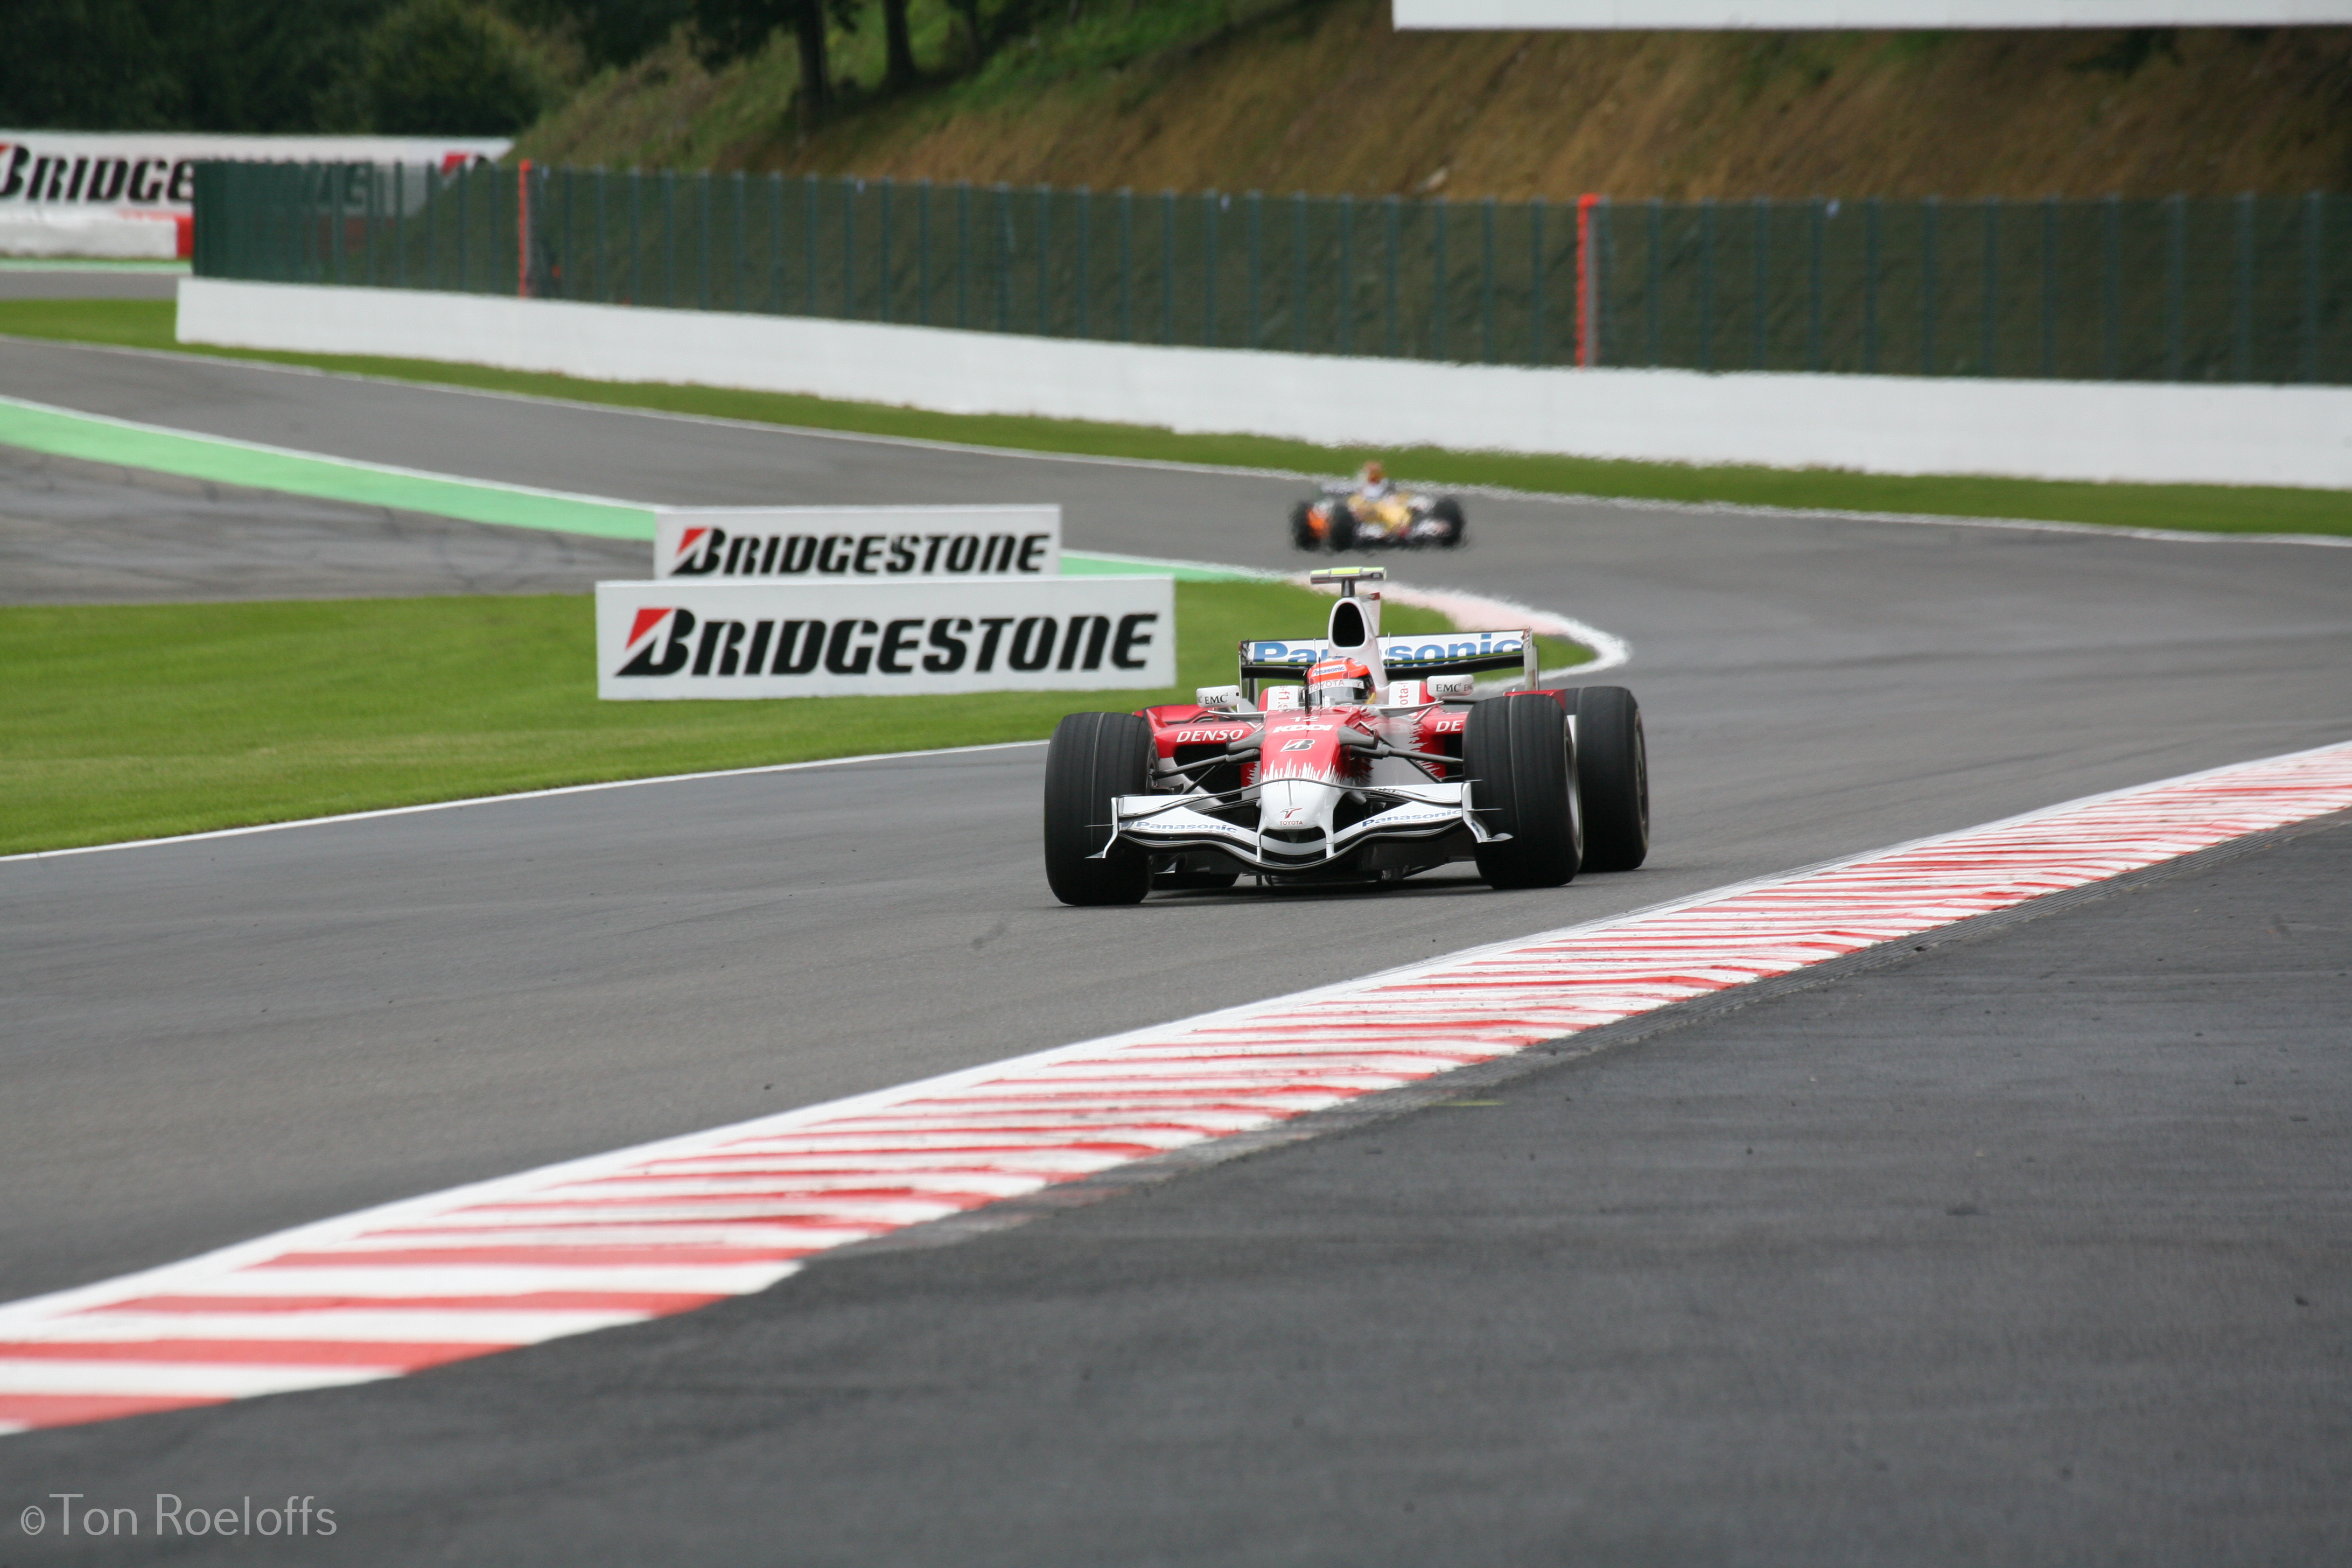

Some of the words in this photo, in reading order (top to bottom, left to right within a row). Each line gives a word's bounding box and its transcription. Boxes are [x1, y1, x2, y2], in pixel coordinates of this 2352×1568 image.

[670, 527, 1050, 575] BRIDGESTONE
[613, 607, 1159, 676] BRIDGESTONE
[1254, 633, 1523, 667] Pasonic
[1310, 680, 1345, 692] TOYOTA
[1272, 724, 1334, 733] KDDI
[1436, 720, 1464, 732] DE
[1176, 730, 1244, 743] DENSO
[1362, 810, 1462, 827] Panasonic
[1136, 821, 1238, 834] Panasonic
